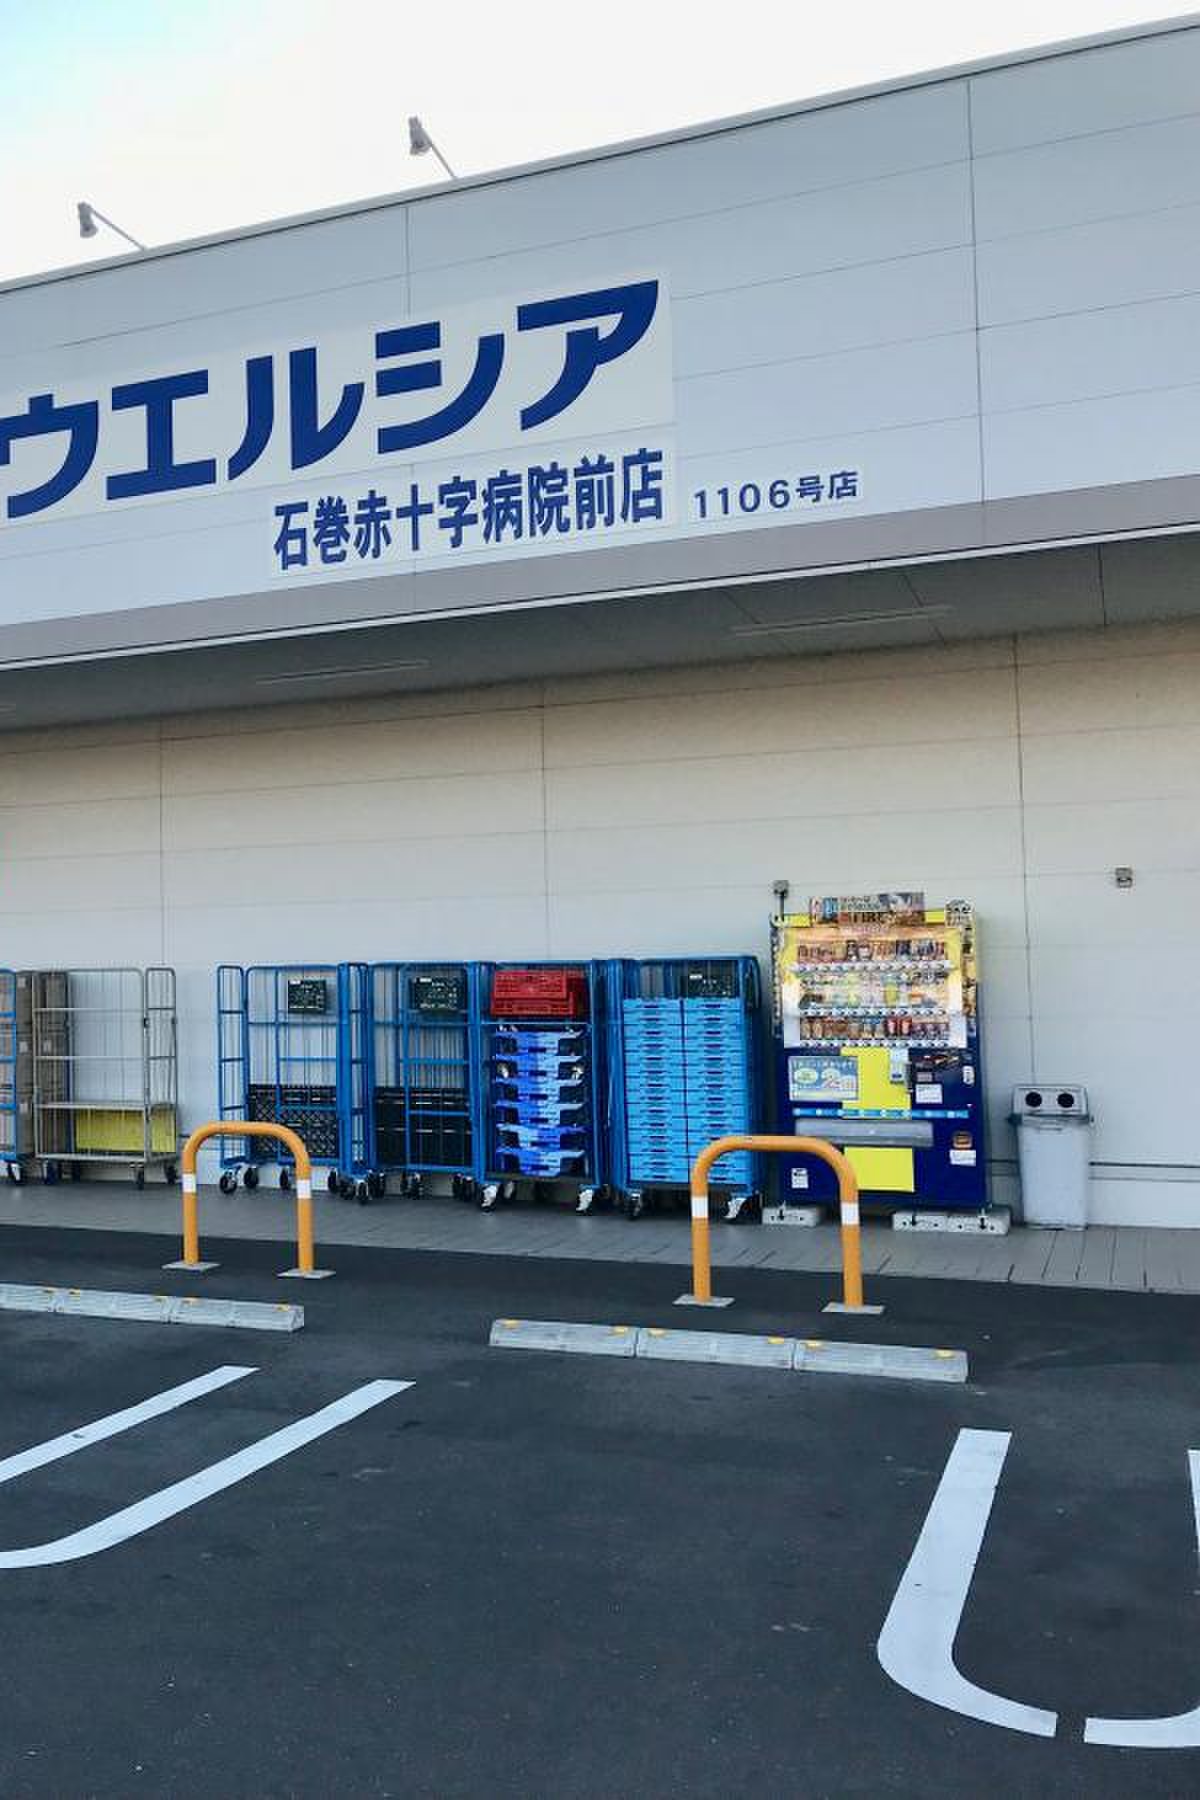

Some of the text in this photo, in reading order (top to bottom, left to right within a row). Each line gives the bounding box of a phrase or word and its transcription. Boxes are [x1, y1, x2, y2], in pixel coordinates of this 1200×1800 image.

[273, 447, 663, 571] 石巻赤十字病院前店
[693, 471, 859, 519] 1106号店
